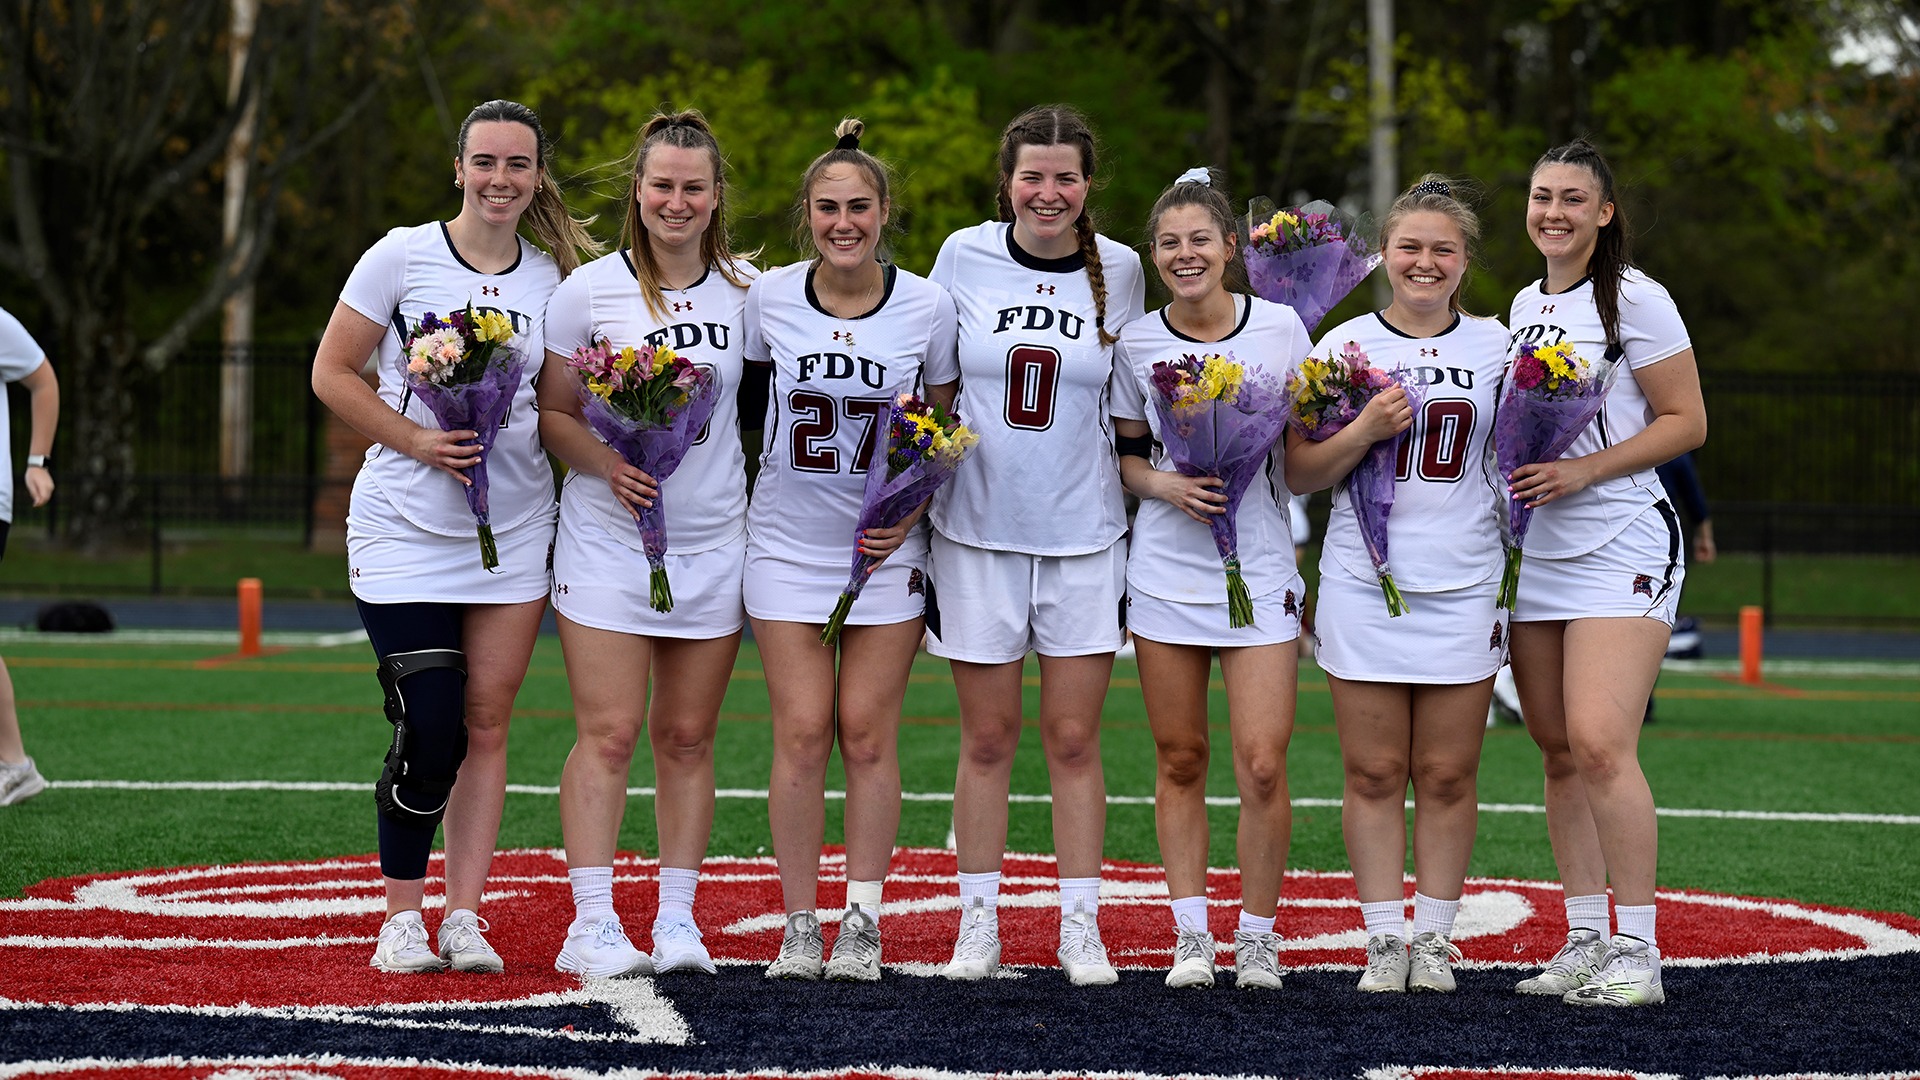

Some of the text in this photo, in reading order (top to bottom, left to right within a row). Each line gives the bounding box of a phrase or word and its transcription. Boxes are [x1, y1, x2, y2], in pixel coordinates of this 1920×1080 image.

[643, 322, 731, 353] FDU
[993, 305, 1085, 340] FDU
[796, 353, 887, 389] FDU
[1003, 343, 1062, 432] 0
[1388, 366, 1475, 389] DU
[788, 389, 893, 474] 27
